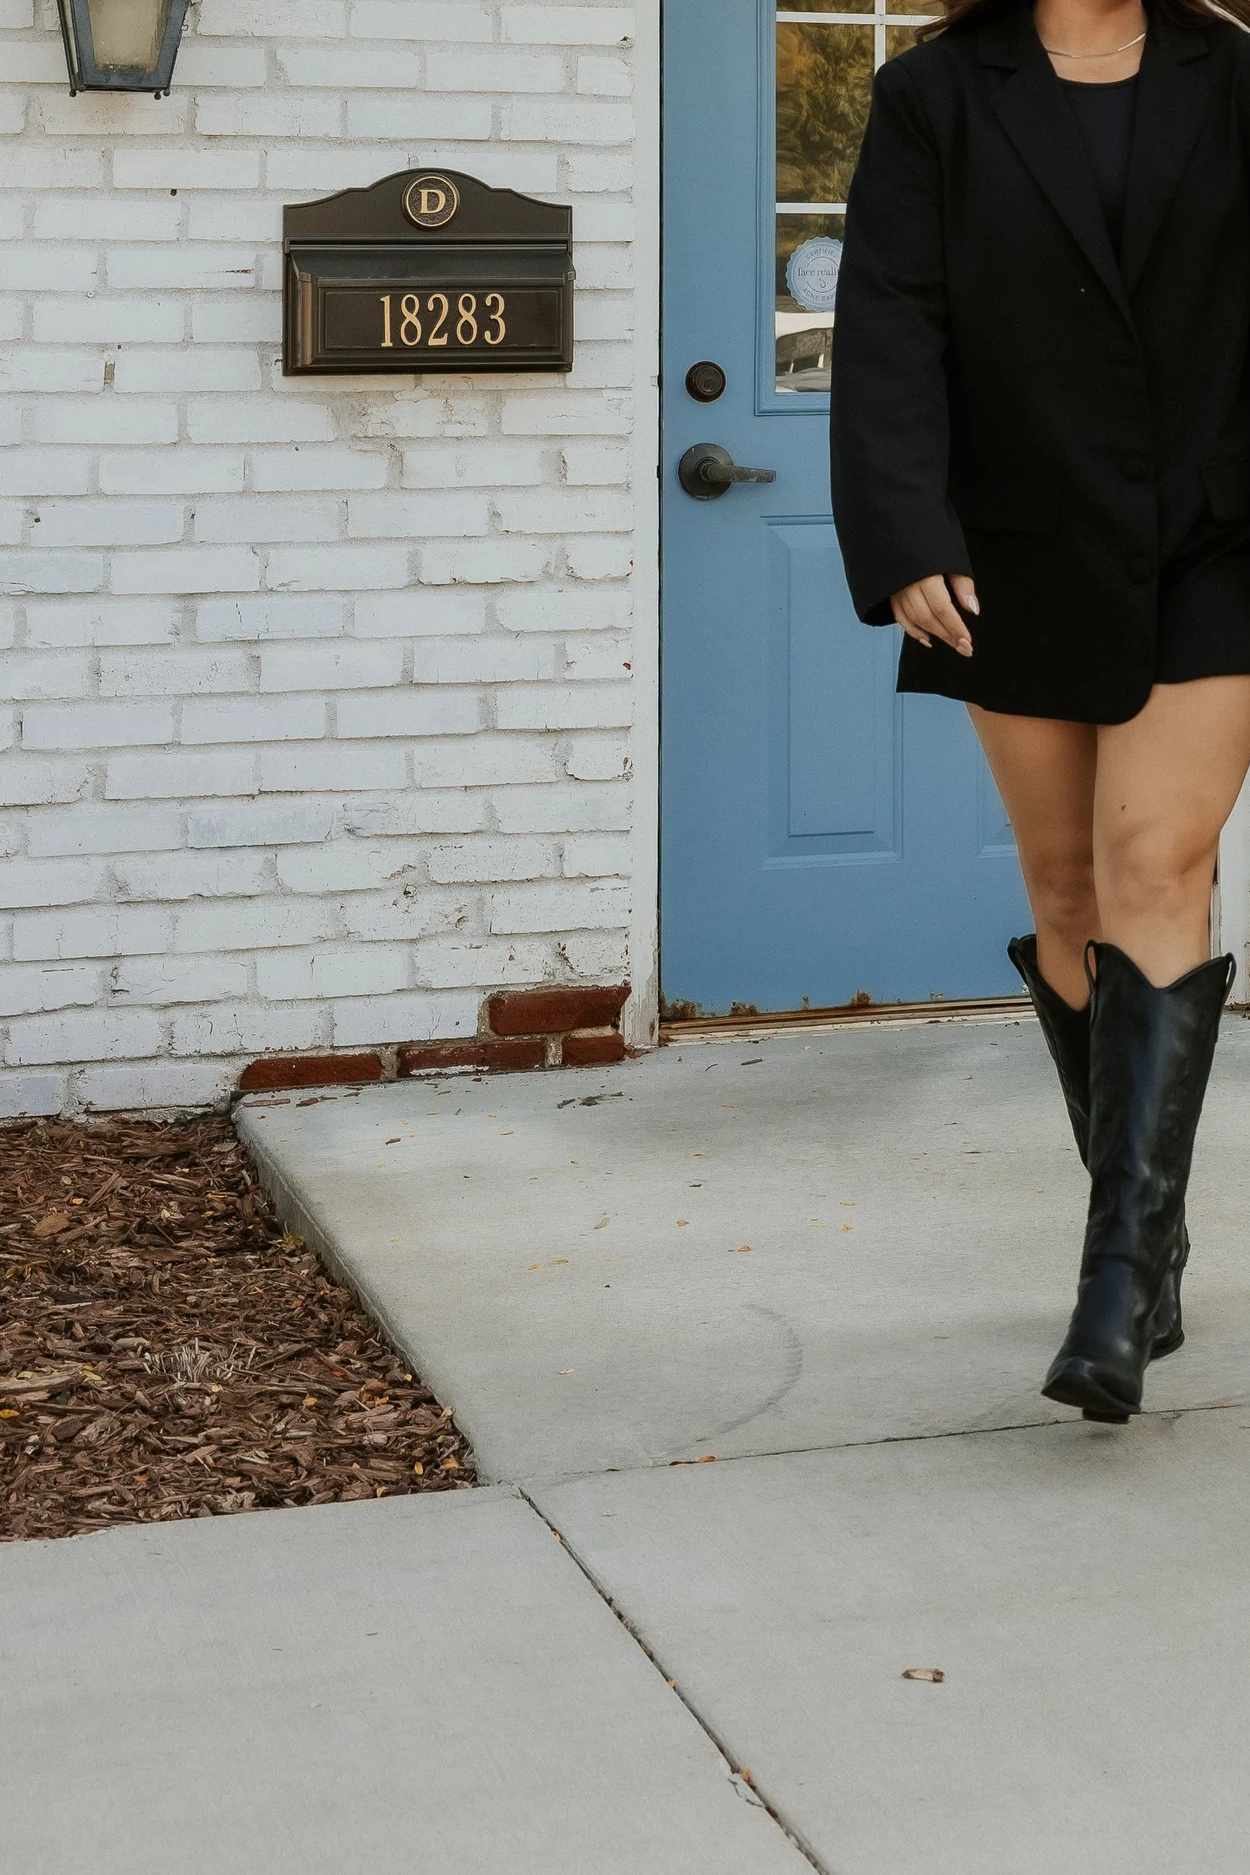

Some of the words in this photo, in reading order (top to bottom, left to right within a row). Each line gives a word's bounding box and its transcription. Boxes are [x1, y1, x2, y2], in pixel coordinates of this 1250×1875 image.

[418, 189, 447, 215] D
[797, 266, 815, 277] face
[817, 266, 838, 277] reali
[379, 293, 507, 348] 18283
